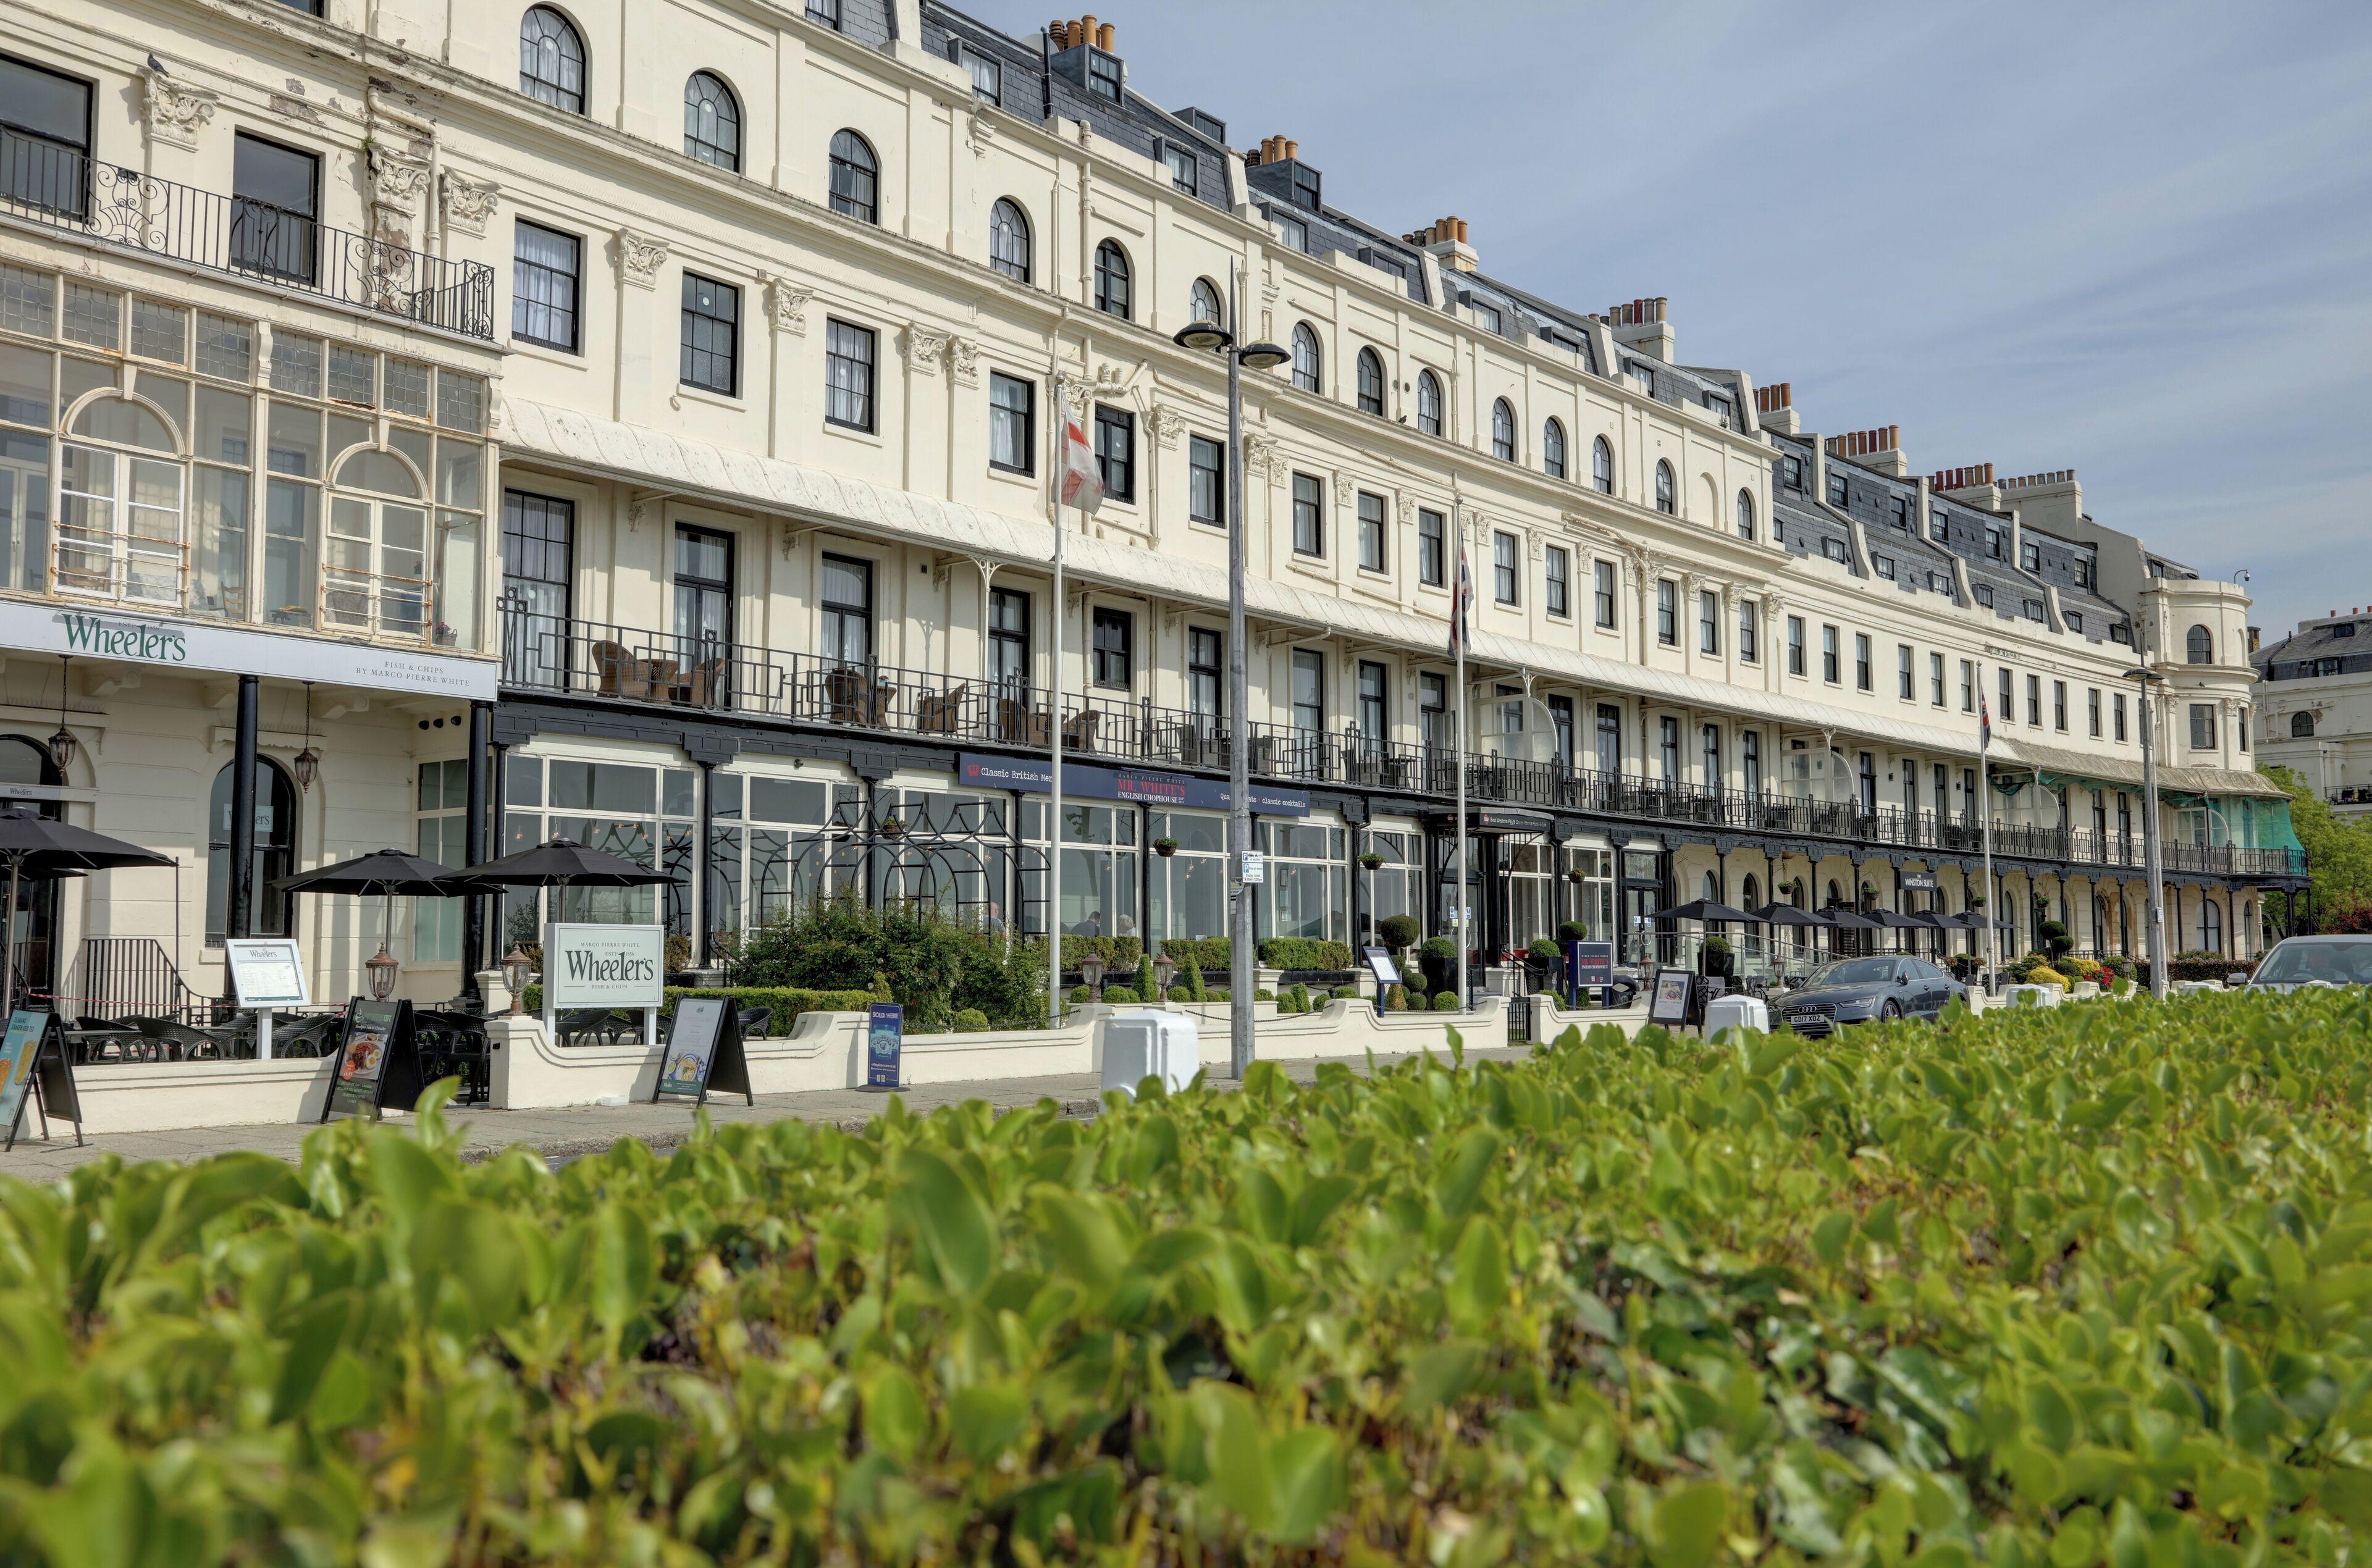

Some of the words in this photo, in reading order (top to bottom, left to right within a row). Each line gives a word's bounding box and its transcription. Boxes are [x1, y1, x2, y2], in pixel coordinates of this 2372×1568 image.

[61, 613, 186, 661] Wheeler's
[385, 661, 405, 669] FISH
[418, 666, 444, 674] CHIPS
[371, 669, 402, 678] MARCO
[406, 674, 437, 682] PIERRE
[440, 677, 469, 686] WHITE
[981, 768, 1009, 778] Classic
[1012, 770, 1038, 781] British
[1041, 774, 1053, 782] Men
[1117, 779, 1137, 790] MR.
[1141, 781, 1185, 796] WHITE'S
[1117, 791, 1142, 800] ENGLISH
[1143, 794, 1177, 803] CHOPHOUSE
[1262, 797, 1281, 805] classic
[1282, 800, 1306, 808] cocktails
[1904, 878, 1924, 887] WINSTON
[565, 950, 654, 981] Wheeler's
